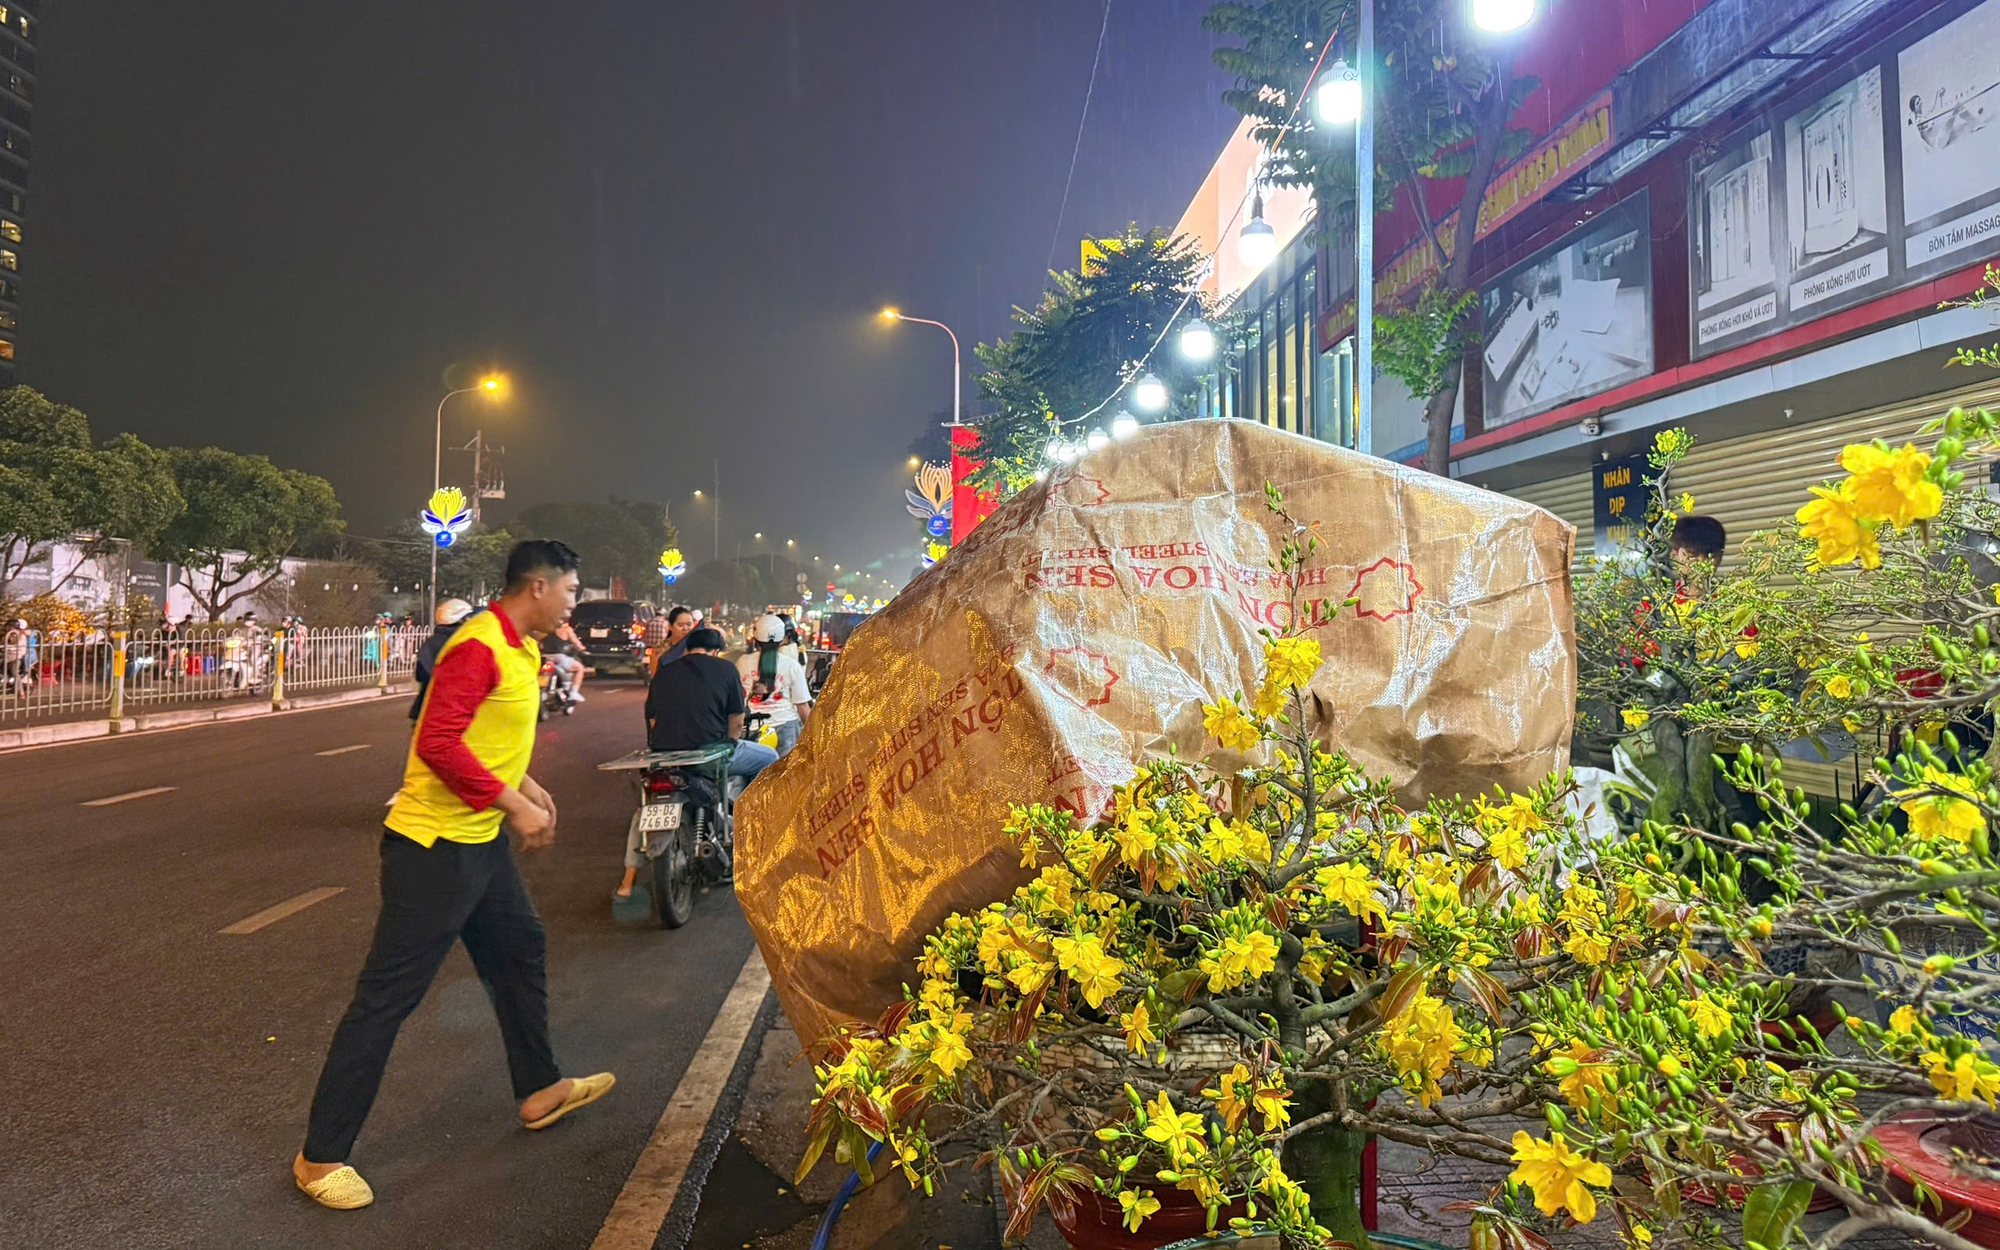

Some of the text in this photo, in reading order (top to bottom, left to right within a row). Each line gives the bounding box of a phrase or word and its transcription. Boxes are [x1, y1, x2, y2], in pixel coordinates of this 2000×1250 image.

[1803, 282, 1825, 300] PHÒNG
[1826, 275, 1844, 292] XÔNG
[1603, 466, 1631, 489] NHÂN
[1609, 496, 1626, 518] DỊP
[1126, 541, 1211, 560] STEEL
[1024, 564, 1115, 590] SEN
[1133, 564, 1232, 596] HOA
[1269, 567, 1328, 589] HOA
[814, 667, 1024, 879] TÔN HOA SEN
[806, 772, 867, 841] SHEET
